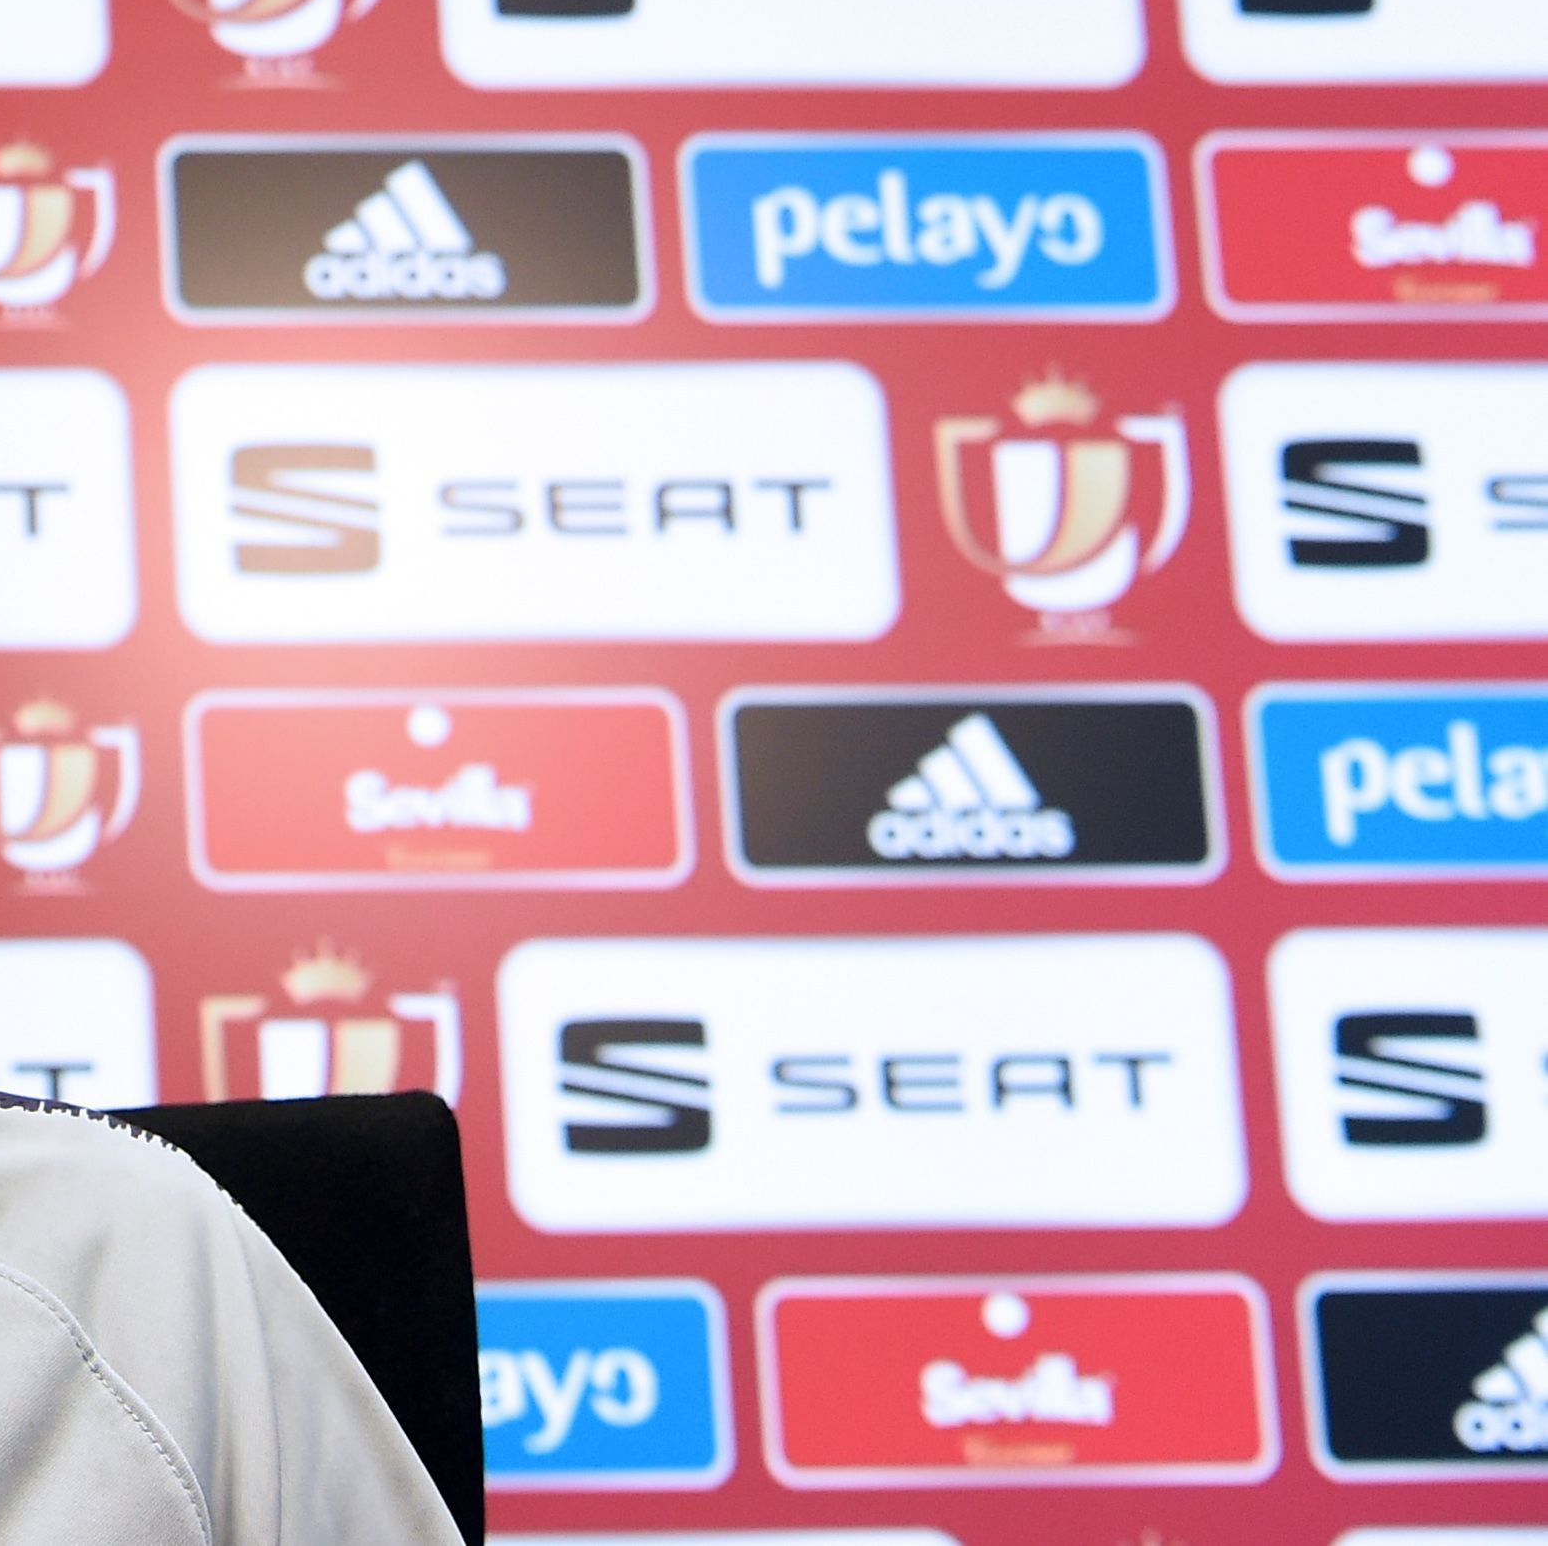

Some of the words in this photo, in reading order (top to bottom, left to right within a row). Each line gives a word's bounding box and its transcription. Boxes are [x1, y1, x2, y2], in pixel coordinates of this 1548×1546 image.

[752, 170, 1101, 289] pelayo
[305, 251, 503, 298] adidas
[439, 478, 832, 536] SEAT
[1321, 722, 1548, 844] pela
[868, 806, 1073, 857] adidas
[769, 1052, 1171, 1114] SEAT
[478, 1349, 659, 1454] ayo
